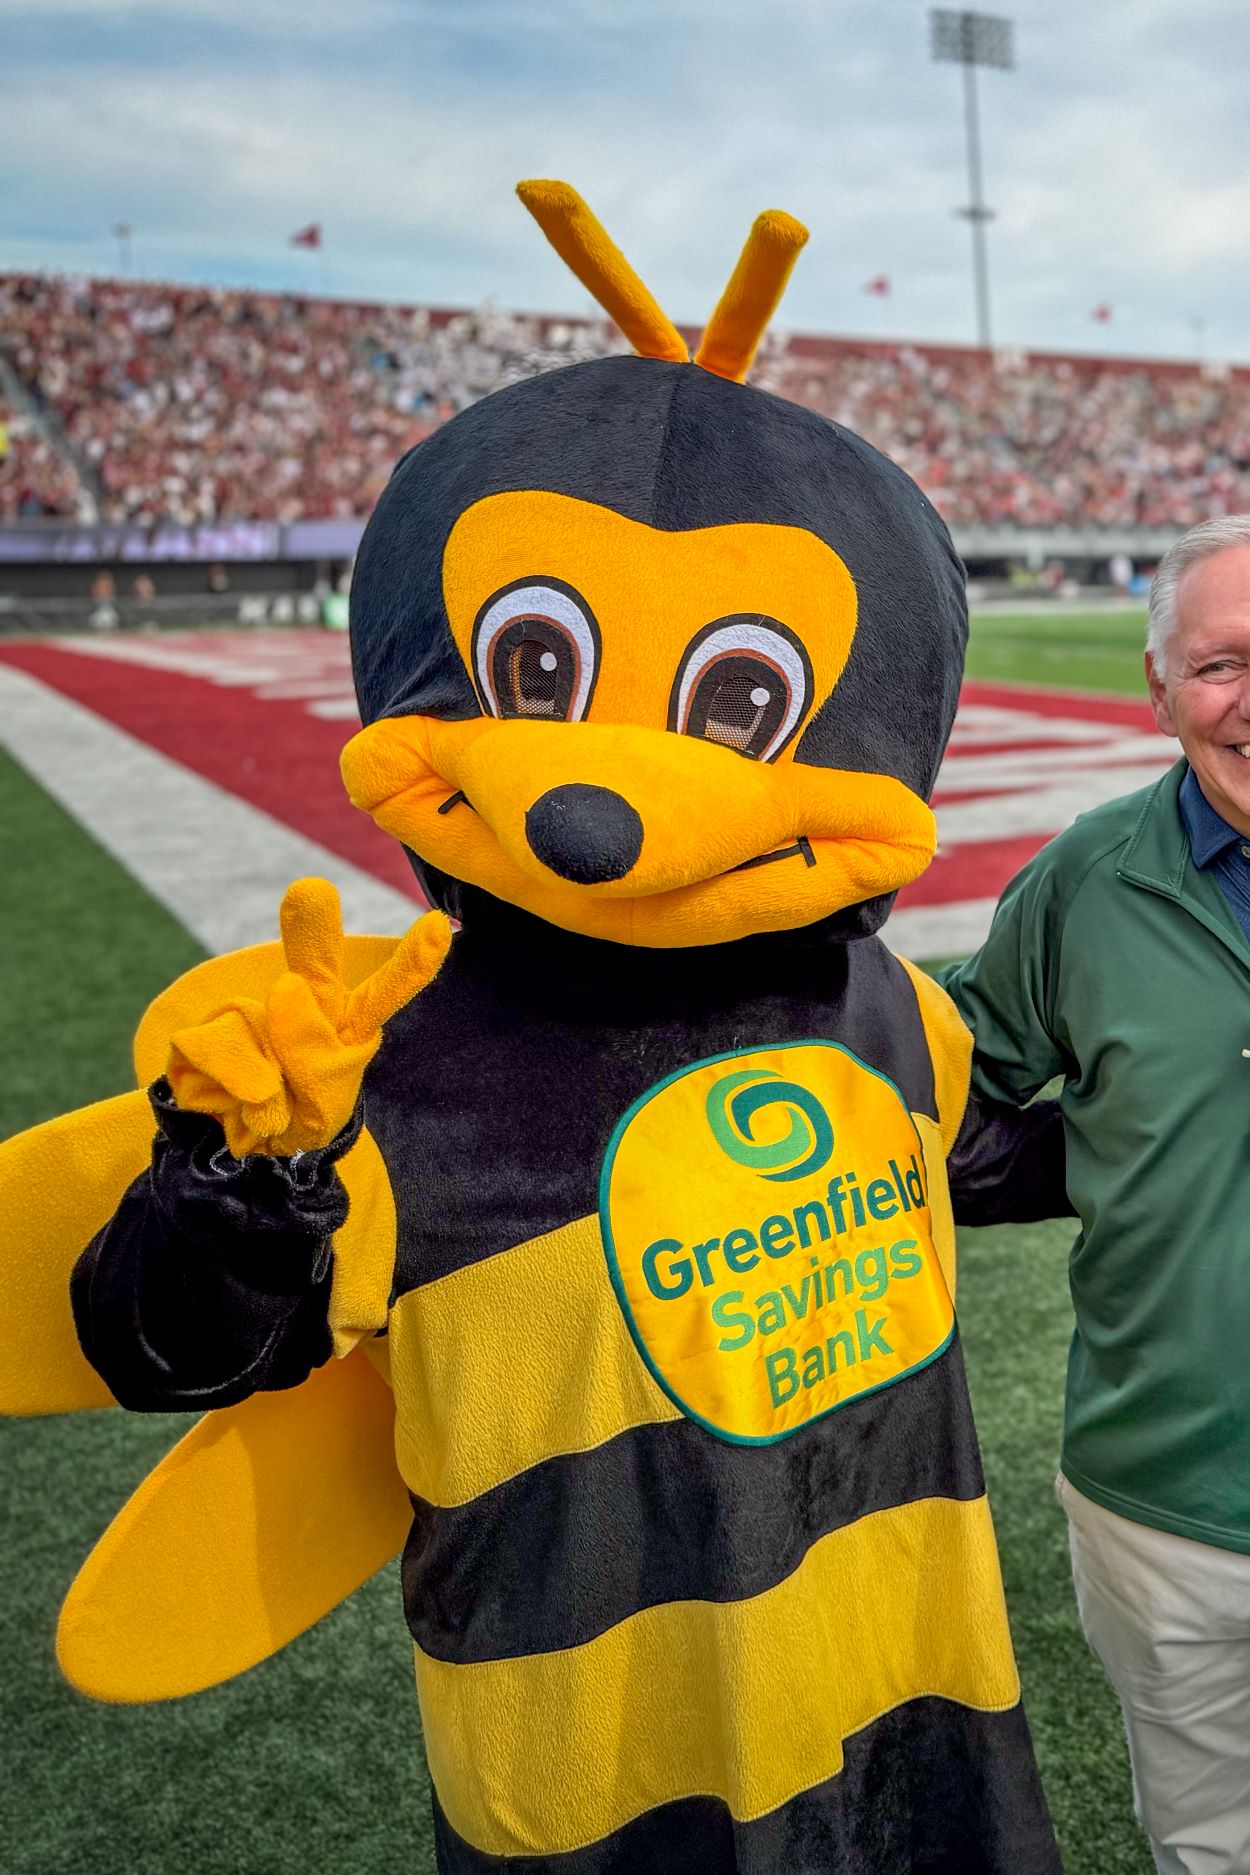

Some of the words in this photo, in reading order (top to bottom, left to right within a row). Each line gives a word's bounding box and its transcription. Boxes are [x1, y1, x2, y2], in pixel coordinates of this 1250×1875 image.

[641, 1155, 926, 1300] Greenfield
[711, 1239, 922, 1352] Savings
[765, 1309, 893, 1409] Bank
